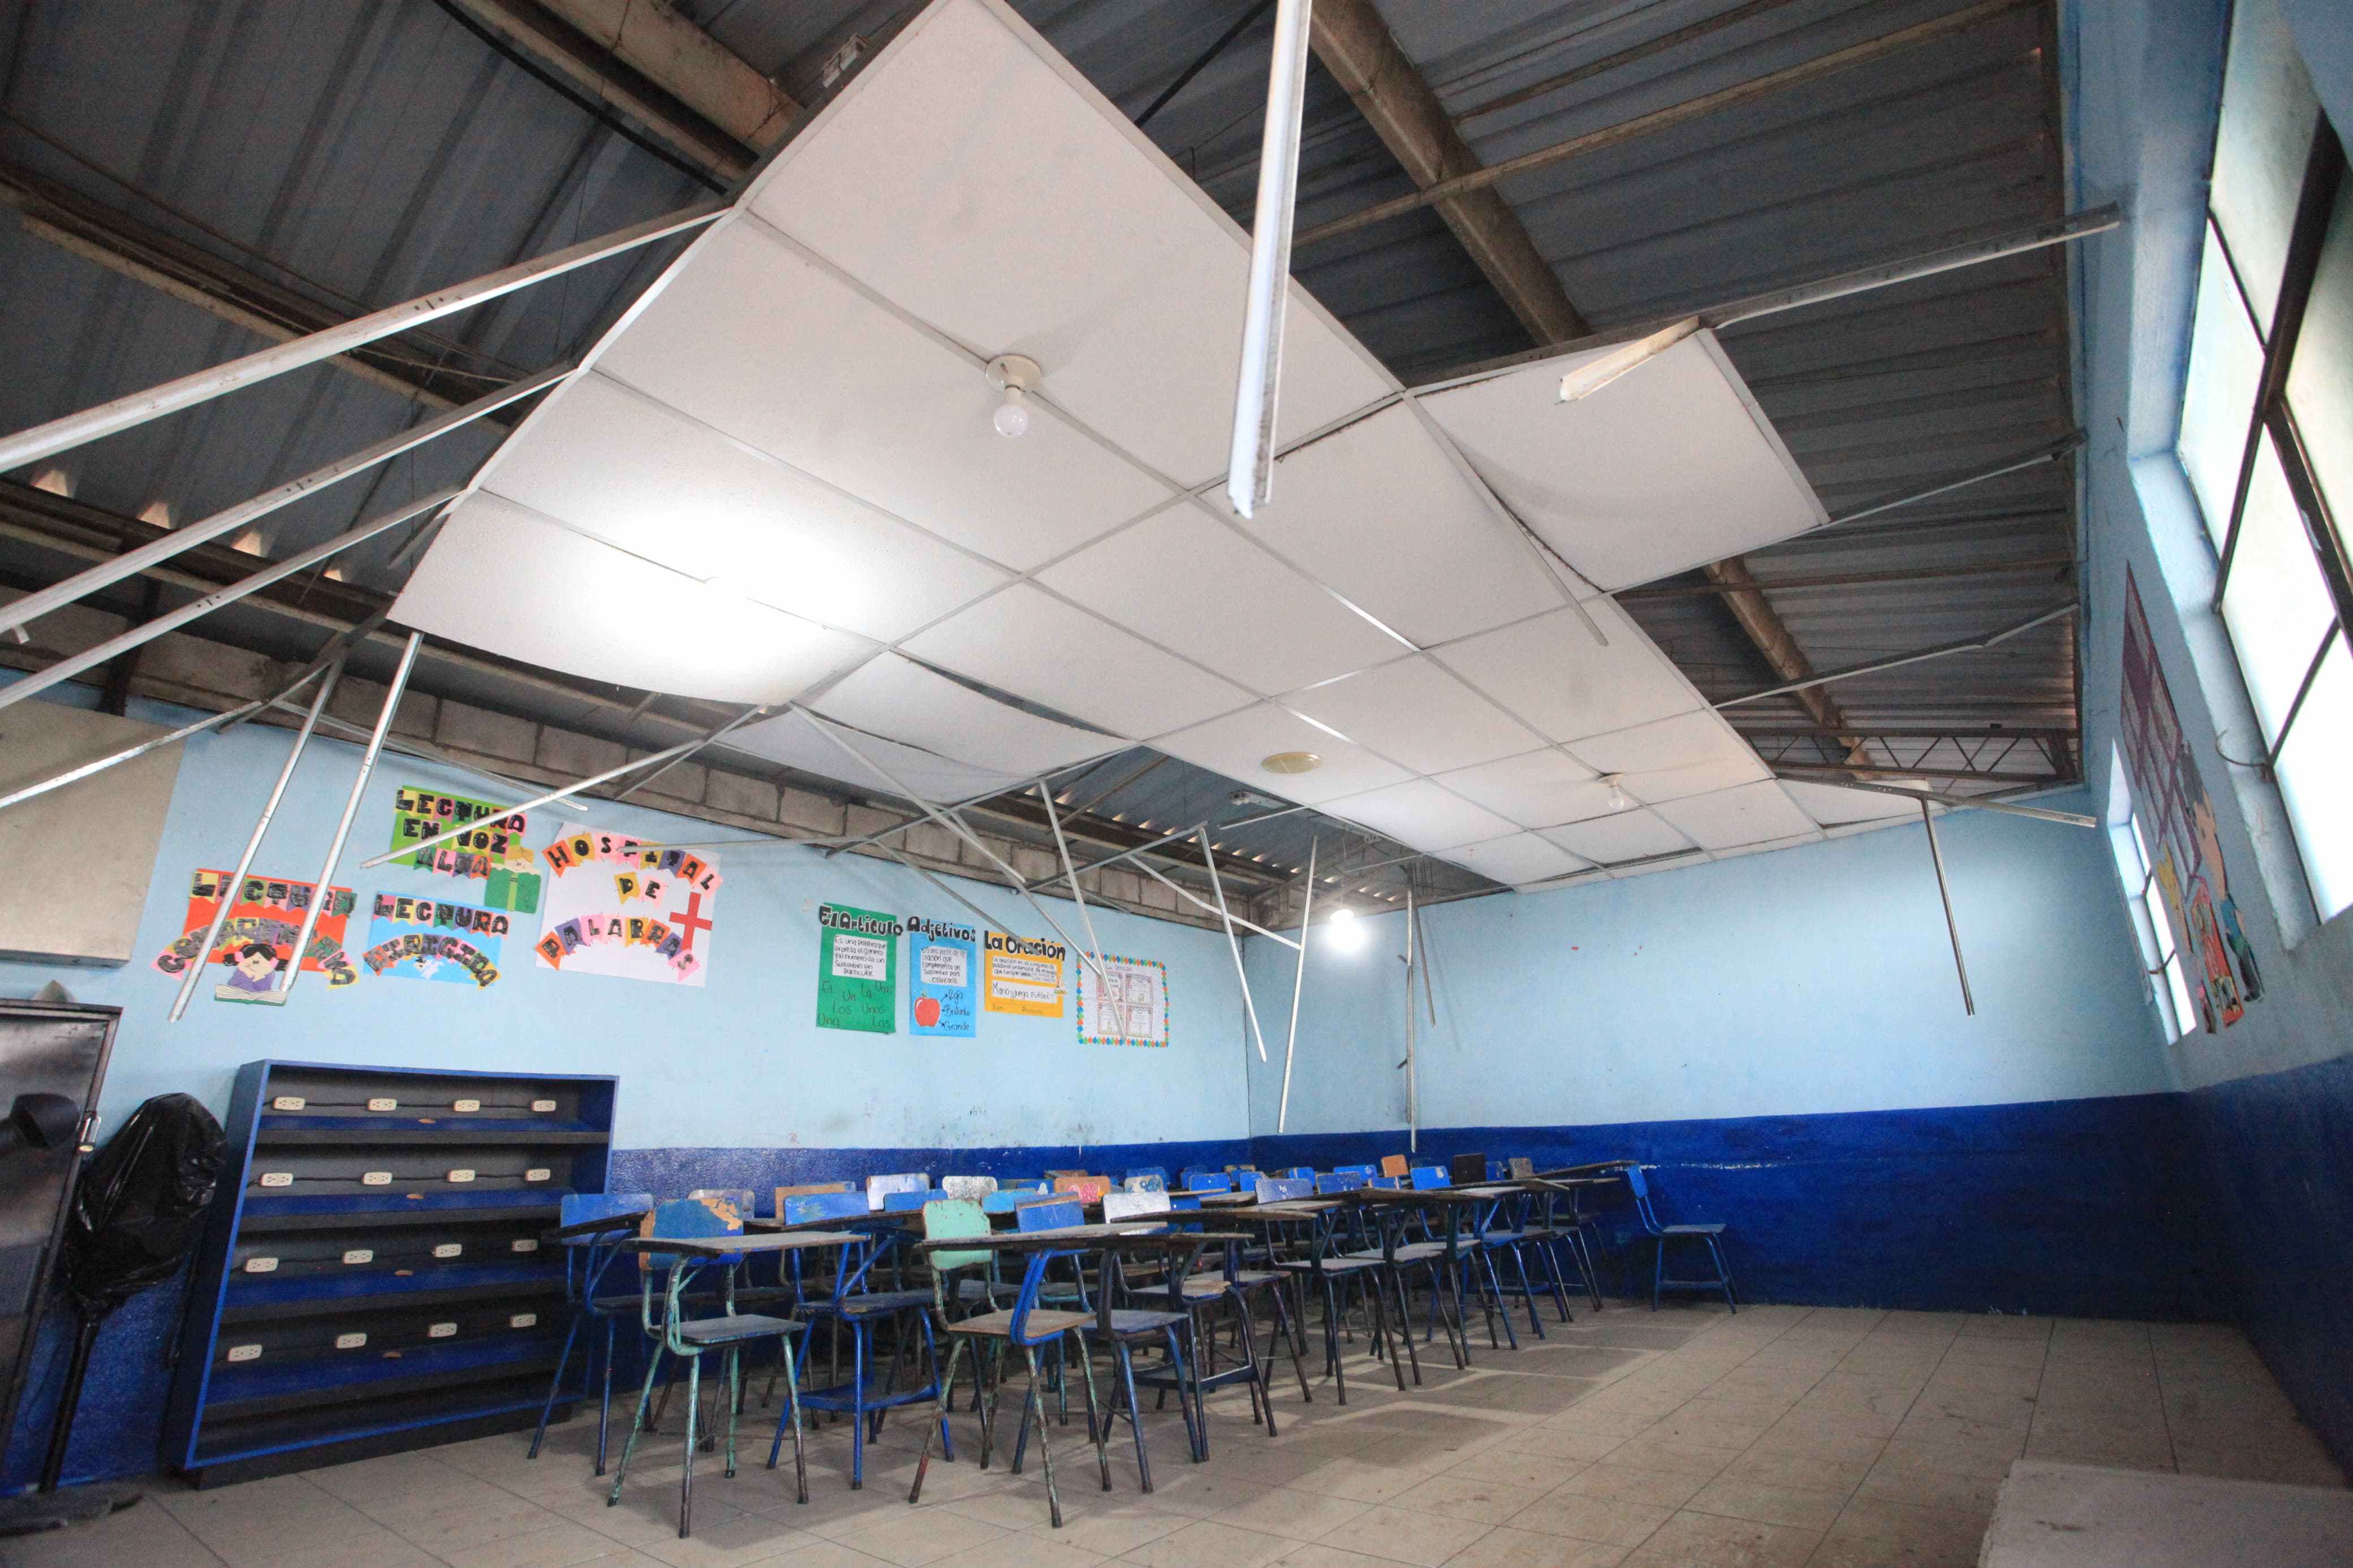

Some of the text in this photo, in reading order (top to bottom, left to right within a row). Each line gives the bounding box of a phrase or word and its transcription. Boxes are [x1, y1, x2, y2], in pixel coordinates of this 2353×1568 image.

[397, 790, 525, 832] LECTURA
[403, 818, 508, 854] EN VOZ
[416, 847, 489, 876] ALTA
[620, 878, 660, 899] DE
[374, 895, 508, 935] LECTURA
[819, 905, 837, 927] El
[908, 916, 976, 942] Adjetivos
[363, 934, 498, 987] DIRIGIDA
[542, 919, 693, 970] PALABRAS
[984, 930, 1066, 961] La Oración
